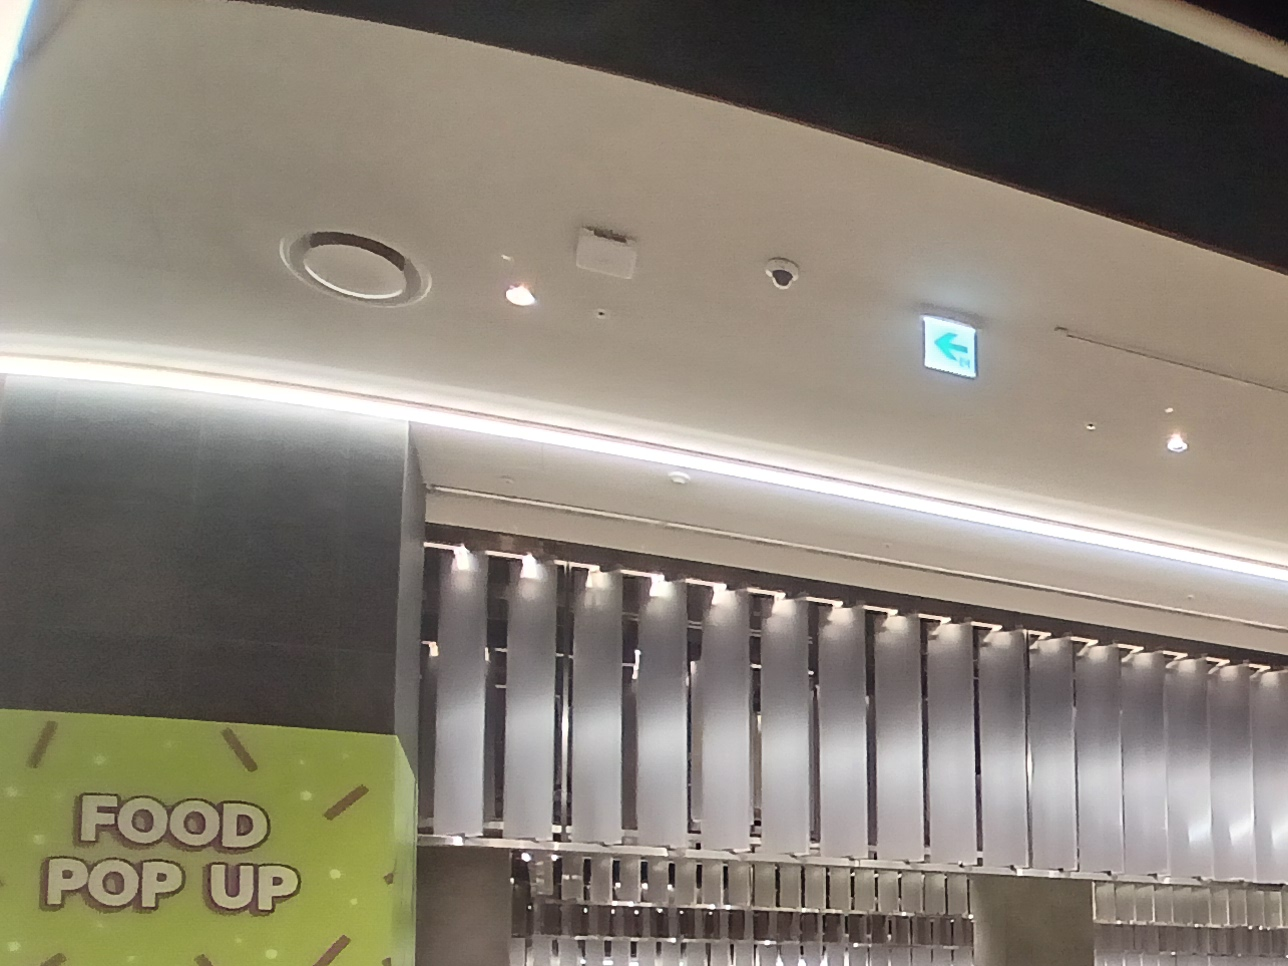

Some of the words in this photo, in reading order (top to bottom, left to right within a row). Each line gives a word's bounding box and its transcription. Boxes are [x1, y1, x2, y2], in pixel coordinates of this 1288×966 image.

[77, 793, 271, 852] FOOD
[43, 857, 187, 911] POP
[205, 863, 302, 915] UP
